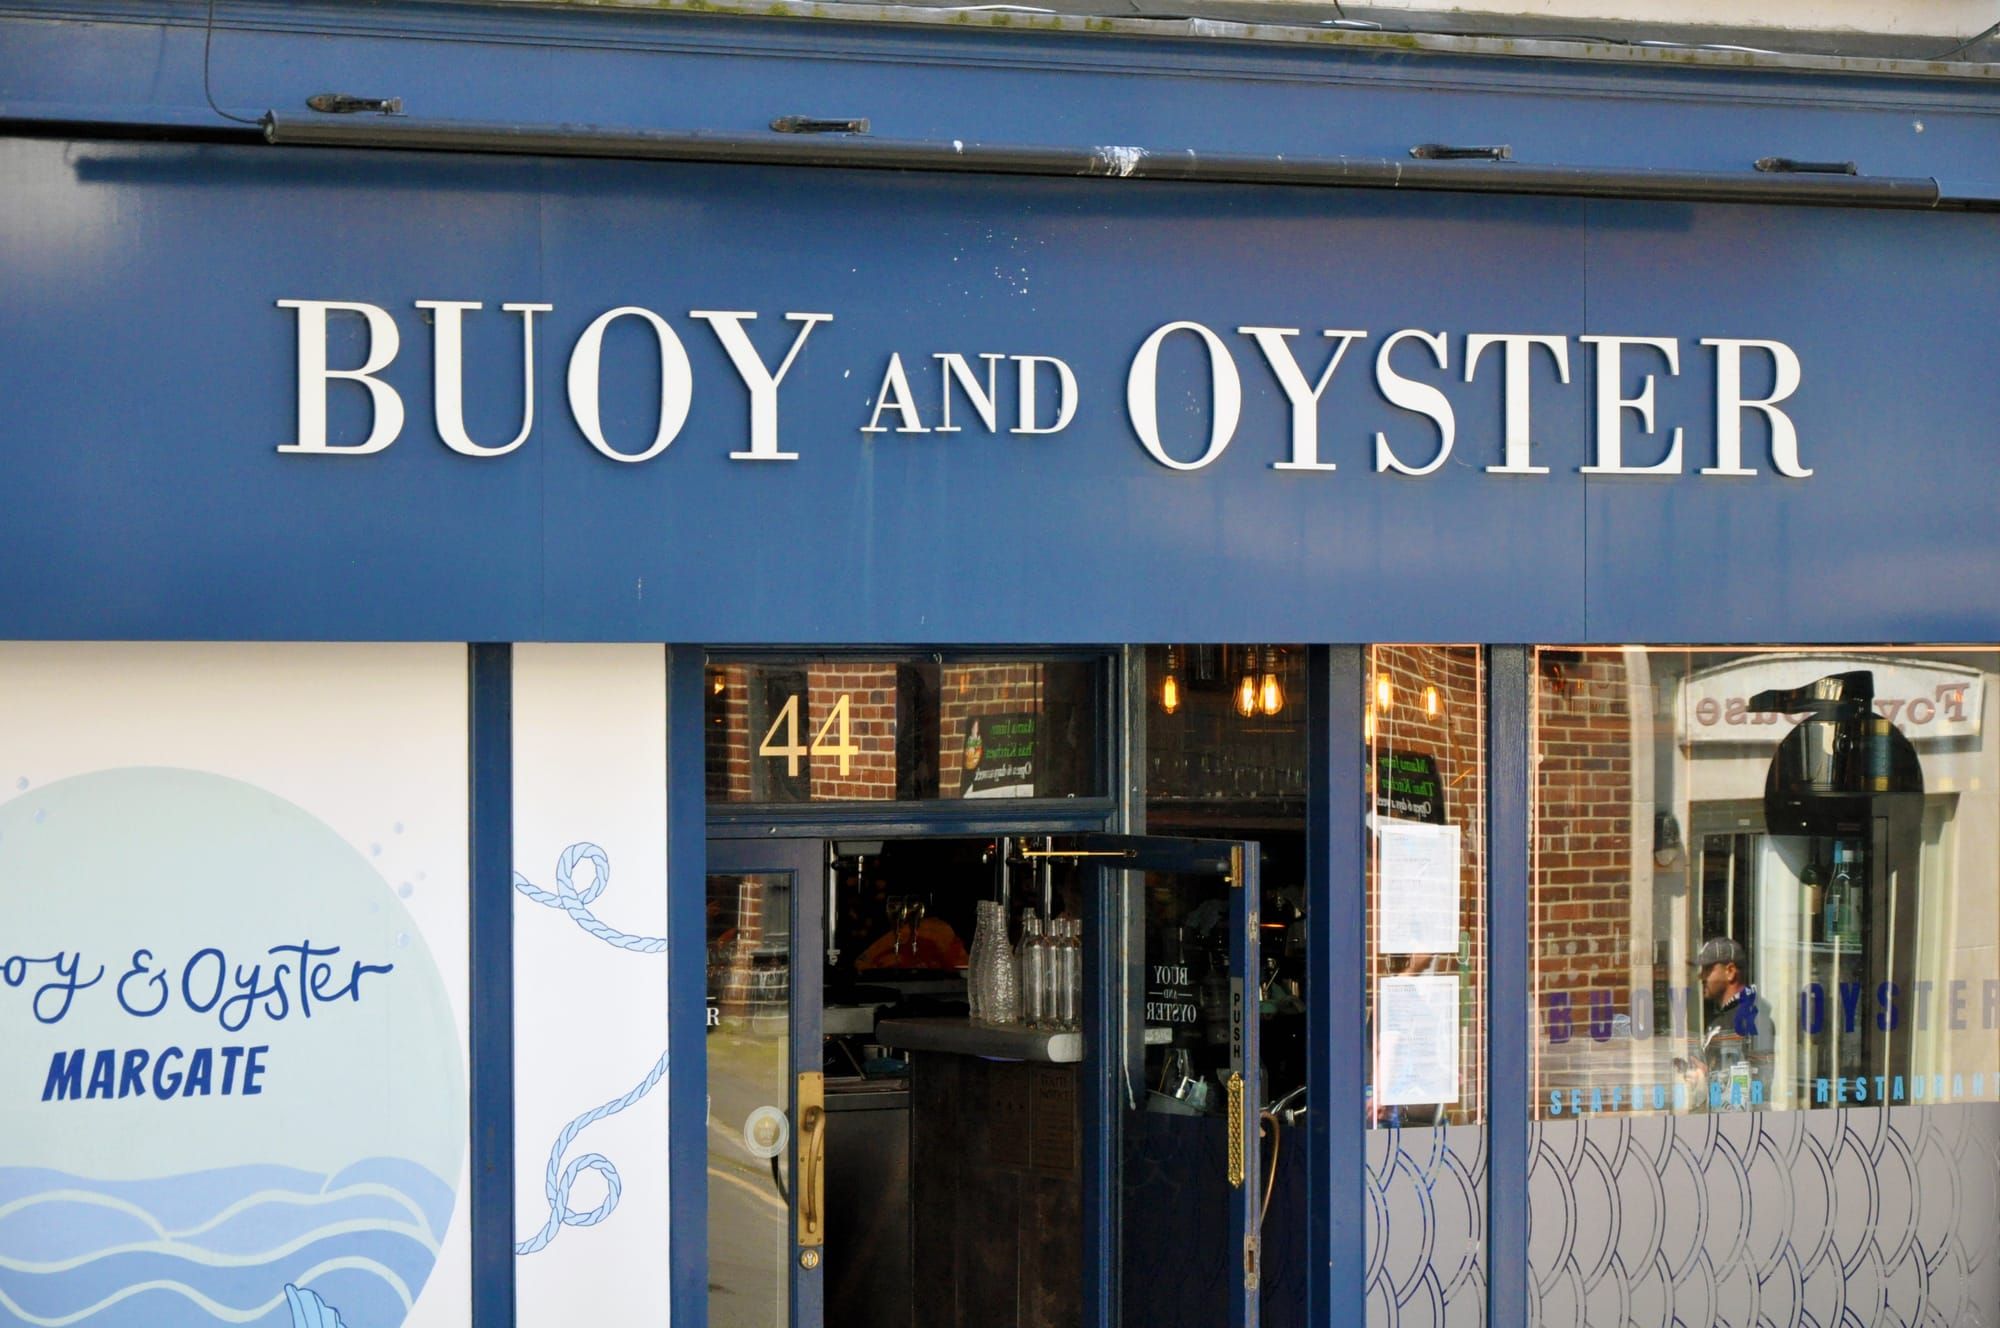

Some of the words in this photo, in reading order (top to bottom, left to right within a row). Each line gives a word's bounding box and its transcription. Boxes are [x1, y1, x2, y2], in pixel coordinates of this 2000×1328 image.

[277, 299, 834, 463] BUOY
[860, 352, 1079, 434] AND
[1127, 320, 1814, 477] OYSTER
[759, 694, 860, 777] 44
[0, 951, 105, 1024] oy
[117, 949, 169, 1017] &
[182, 940, 394, 1032] Oyster
[1549, 987, 1692, 1043] BUOY
[1233, 993, 1241, 1058] PUSH
[41, 1045, 270, 1102] MARGATE
[1550, 1082, 1687, 1115] SEAFOOD
[1710, 1080, 1765, 1107] BAR
